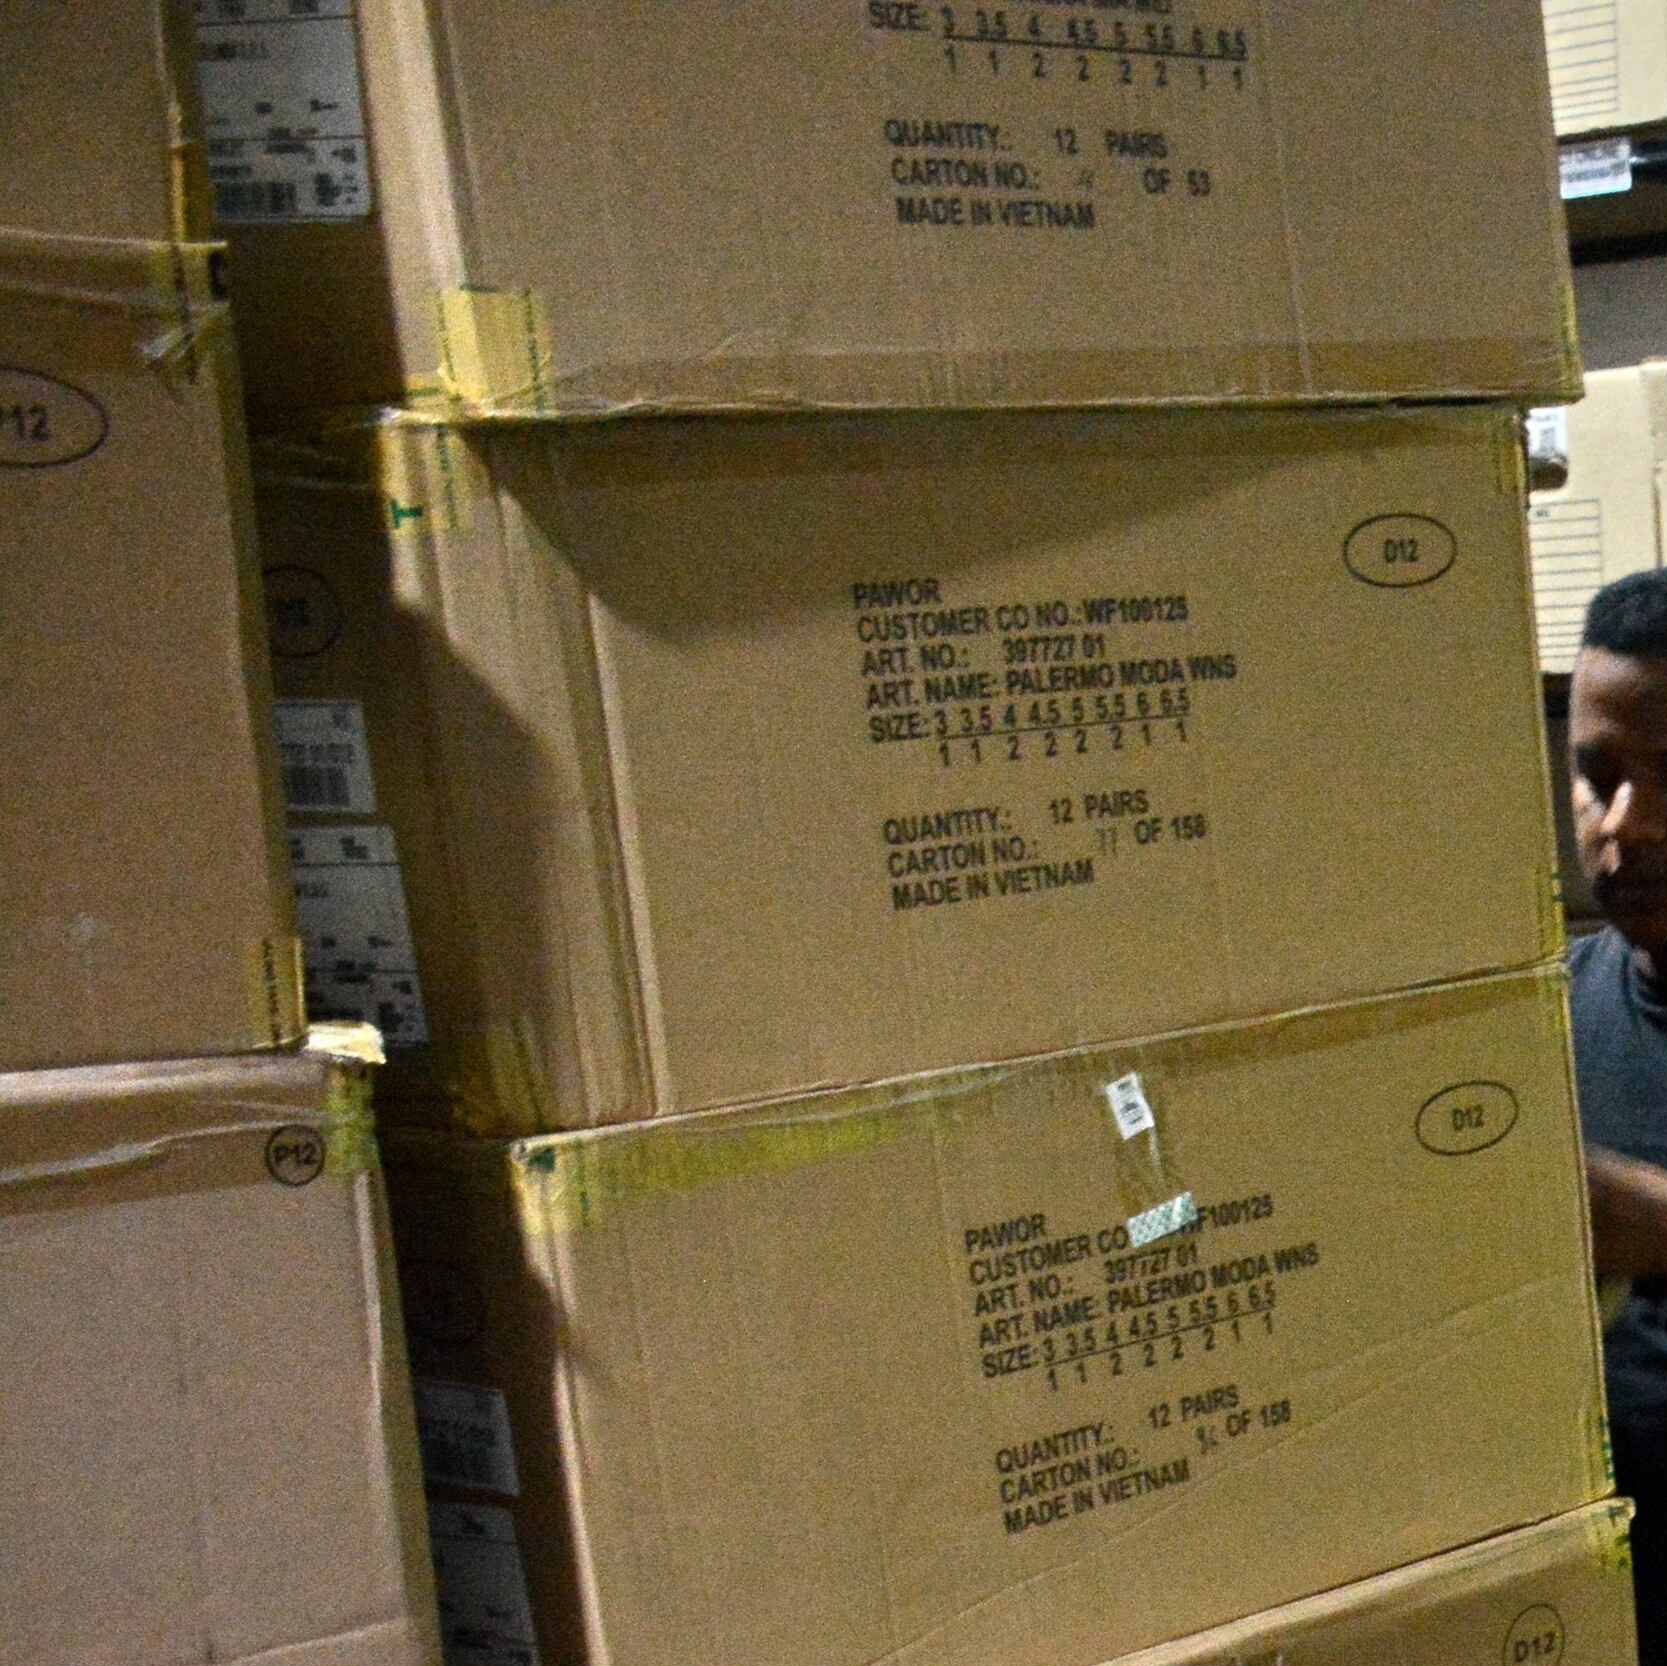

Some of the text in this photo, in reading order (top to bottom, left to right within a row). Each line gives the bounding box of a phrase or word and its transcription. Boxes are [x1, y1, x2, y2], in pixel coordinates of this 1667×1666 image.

[1053, 128, 1079, 155] 12
[1106, 130, 1167, 158] PAIRS
[892, 158, 987, 187] CARTON
[1144, 168, 1171, 195] OF
[896, 197, 1094, 229] MADE IN VIETNAM
[853, 578, 940, 609] PAWOR
[857, 604, 1029, 642] CUSTOMER CO
[1006, 663, 1114, 695] PALERMO
[1119, 657, 1184, 686] MODA
[1050, 798, 1073, 824] 12
[1084, 789, 1149, 820] PAIRS
[888, 843, 985, 878] CARTON
[1134, 818, 1163, 845] OF
[892, 858, 1094, 911] MADE IN VIETNAM
[1452, 1105, 1484, 1131] D12
[965, 1213, 1046, 1255] PAWOR
[969, 1225, 1128, 1285] CUSTOMER CO
[1107, 1269, 1207, 1313] PALERMO
[1211, 1254, 1270, 1289] MODA
[1274, 1242, 1319, 1274] WNS
[1148, 1403, 1171, 1429] 12
[1179, 1384, 1239, 1422] PAIRS
[1000, 1456, 1090, 1504] CARTON
[1226, 1410, 1251, 1438] OF
[1005, 1458, 1190, 1536] MADE IN VIETNAM
[1514, 1632, 1555, 1663] D12
